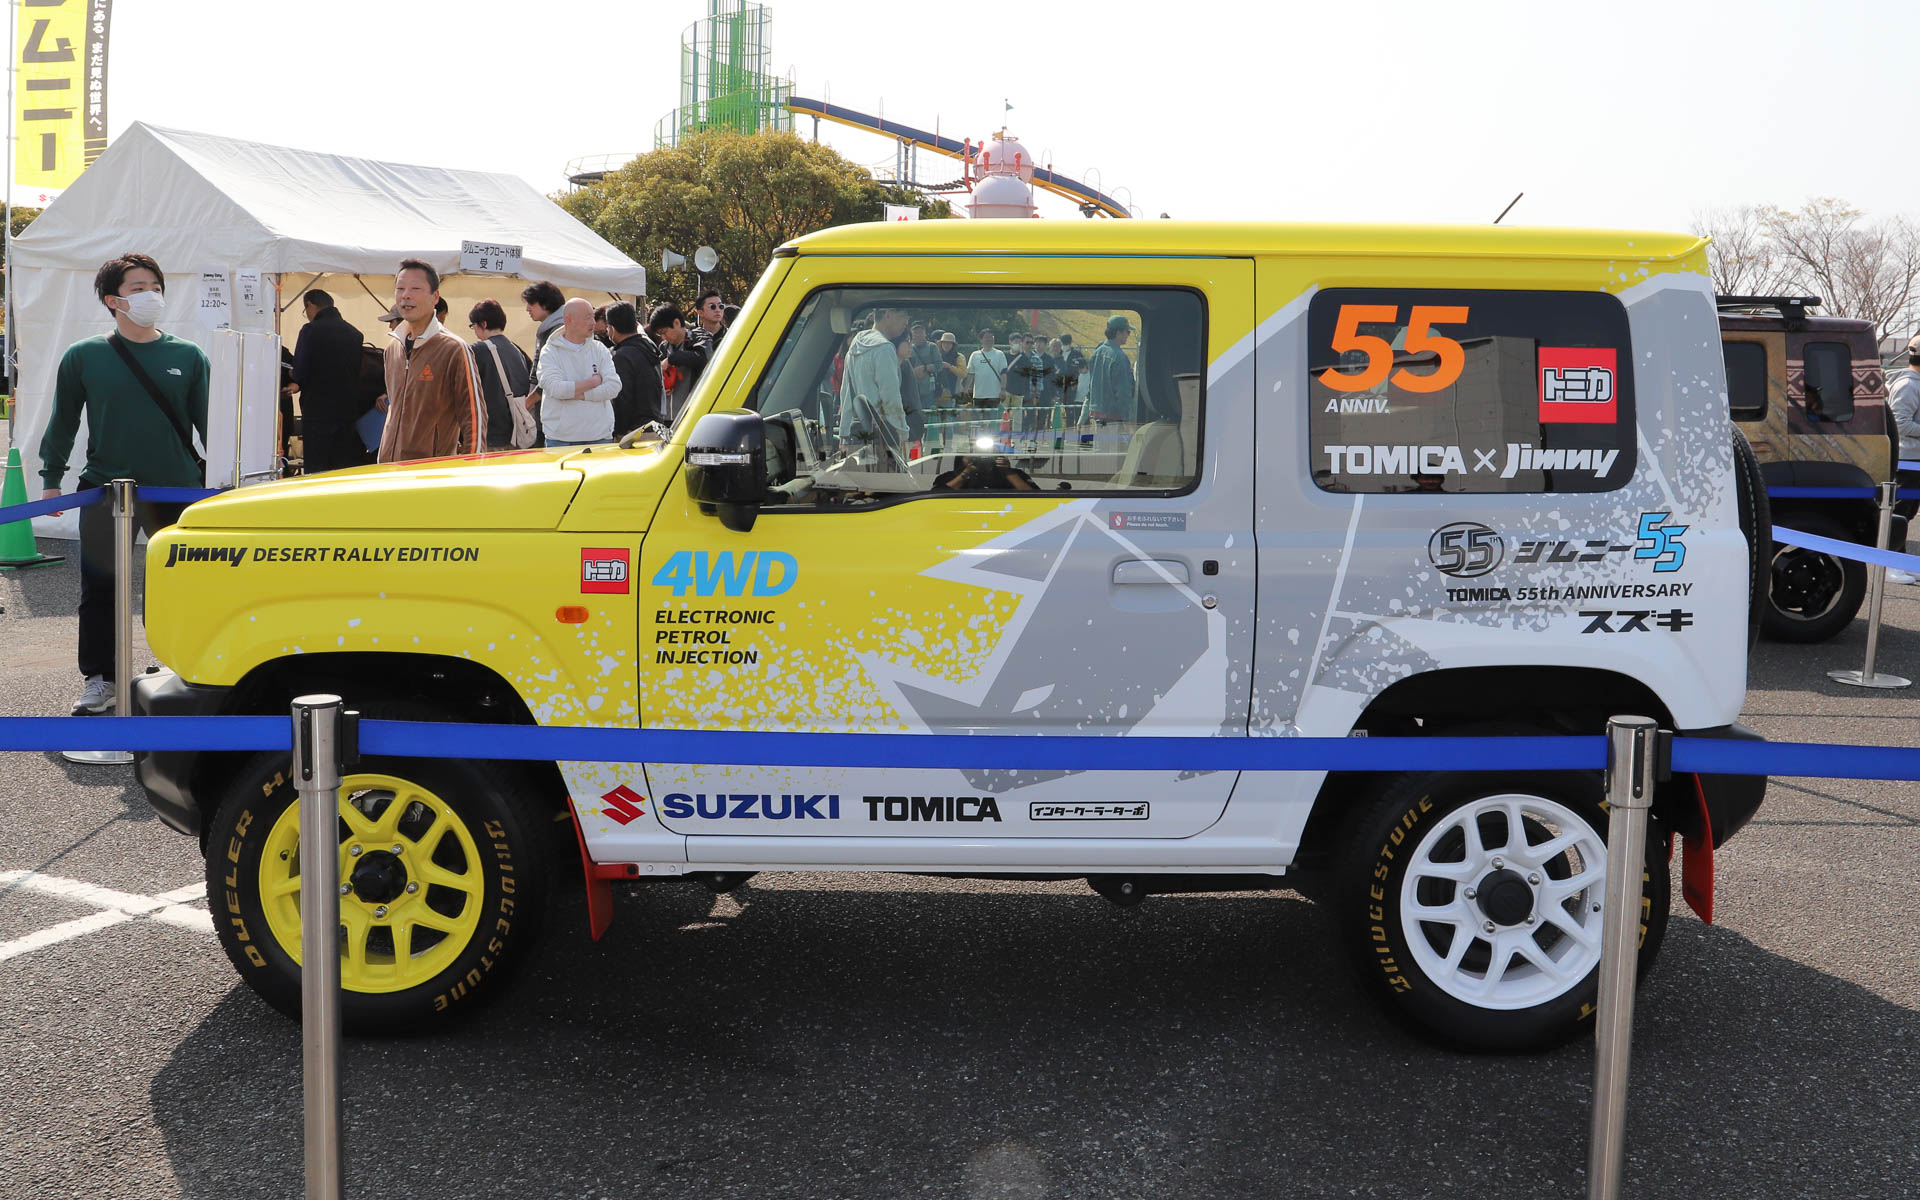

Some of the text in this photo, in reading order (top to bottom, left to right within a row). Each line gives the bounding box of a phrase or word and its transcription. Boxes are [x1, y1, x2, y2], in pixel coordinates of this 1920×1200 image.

[22, 0, 77, 171] ムニー
[1318, 304, 1470, 394] 55
[1542, 366, 1615, 404] トミカ
[1324, 398, 1391, 414] ANNIV.
[1324, 445, 1468, 475] TOMICA
[1500, 443, 1620, 479] Jimny
[1512, 512, 1690, 573] ジムニー 55
[165, 544, 480, 567] Jimny DESERT RALLY EDITION
[583, 560, 627, 582] トミカ
[652, 551, 799, 597] 4WD
[1446, 583, 1694, 602] TOMICA 55th ANNIVERSARY
[655, 610, 776, 625] ELECTRONIC
[1578, 609, 1694, 634] スズキ
[655, 630, 731, 645] PETROL
[655, 650, 758, 665] INJECTION
[662, 793, 840, 820] SUZUKI
[862, 796, 1003, 822] TOMICA
[1034, 804, 1146, 817] インタークーラーターボ
[226, 809, 269, 968] DUELER
